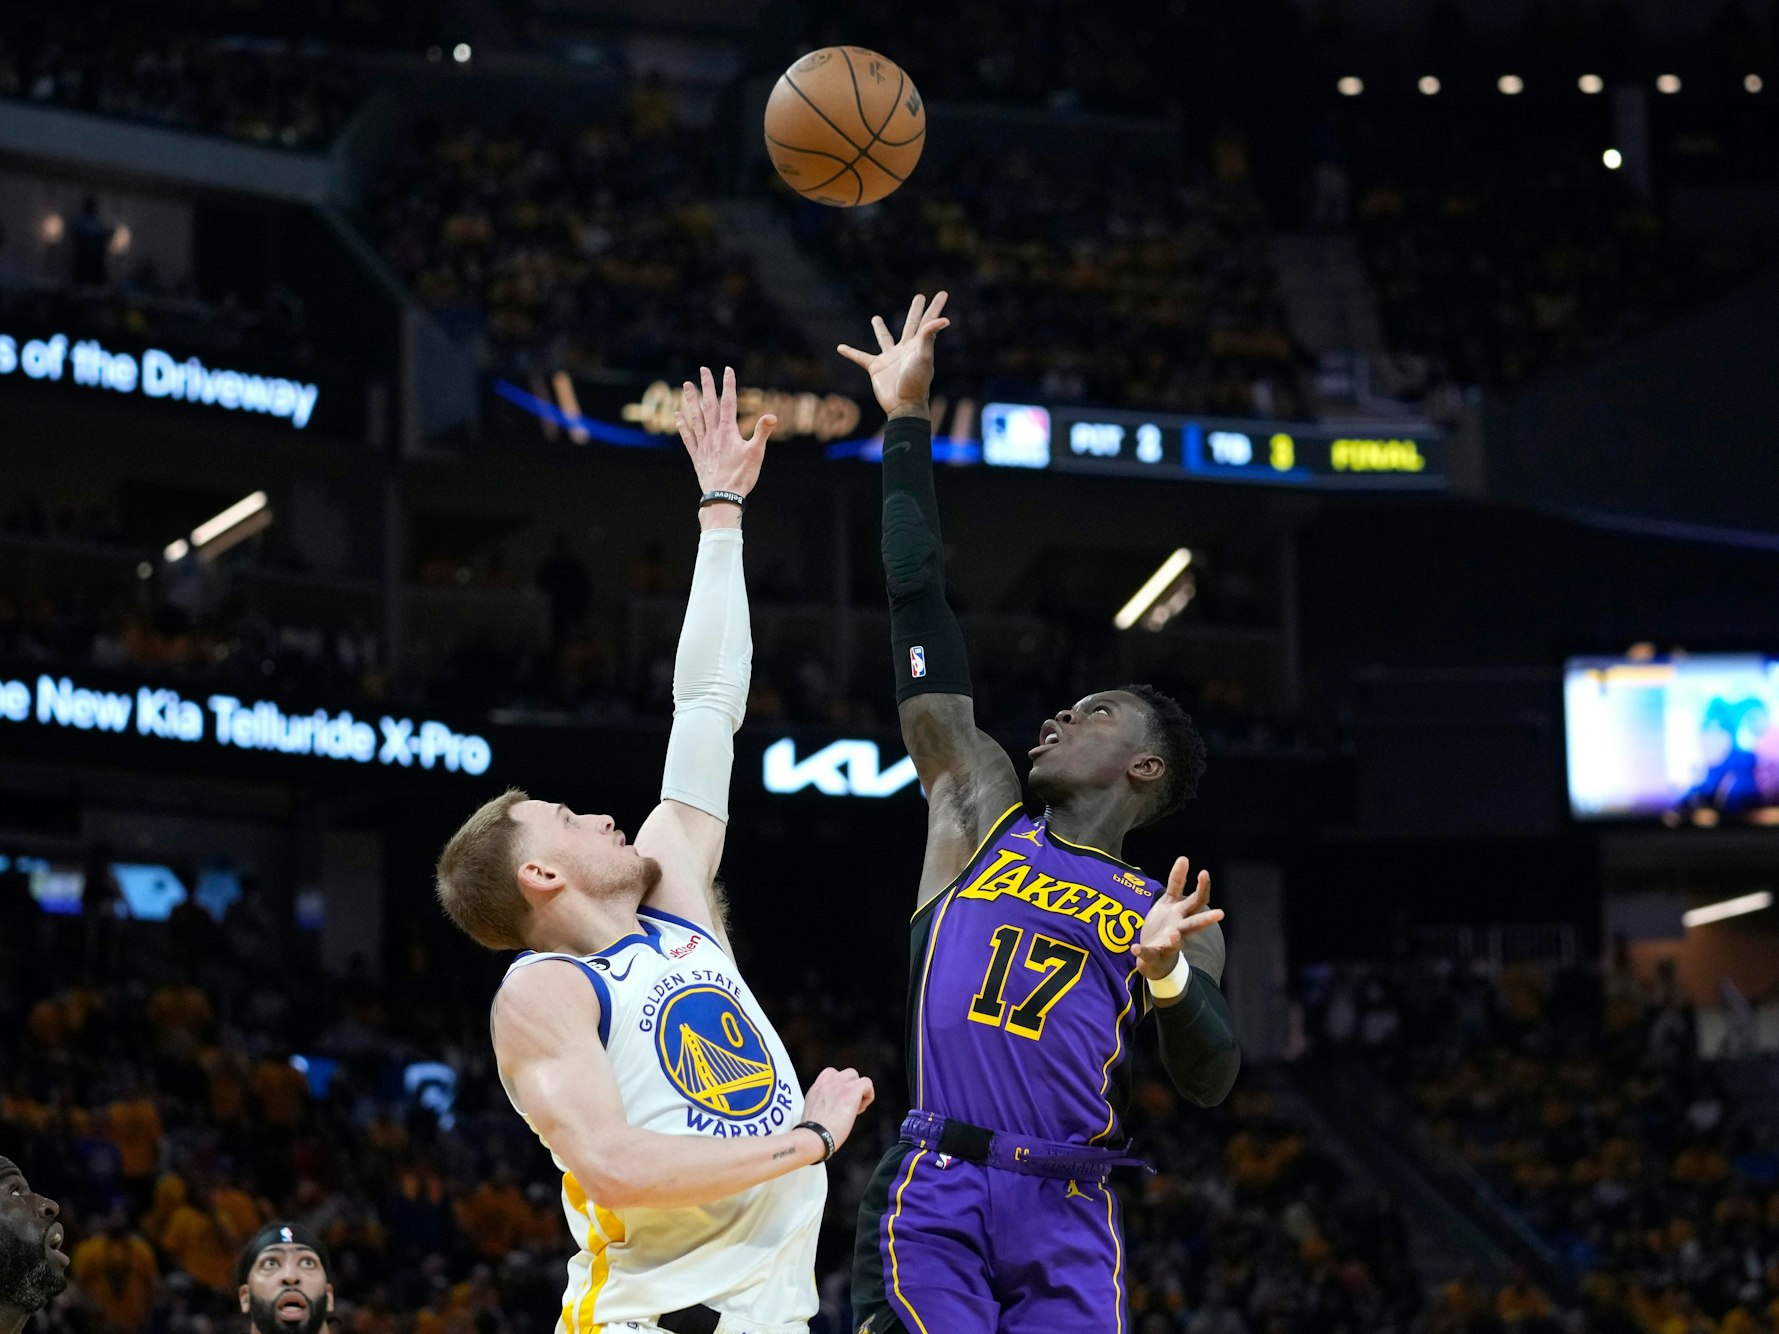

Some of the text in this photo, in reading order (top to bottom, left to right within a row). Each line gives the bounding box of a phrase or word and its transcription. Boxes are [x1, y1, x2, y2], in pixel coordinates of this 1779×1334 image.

[21, 333, 68, 379] of
[72, 341, 138, 392] the
[143, 350, 318, 427] Driveway
[1331, 439, 1424, 471] FINAL
[714, 491, 743, 504] Believe
[0, 675, 491, 775] e New Kia Telluride X-Pro
[956, 849, 1146, 954] LAKERS
[1112, 873, 1152, 897] bibigo
[639, 969, 742, 1033] GOLDEN STATE
[967, 924, 1090, 1041] 17
[720, 1010, 744, 1048] 0
[685, 1078, 793, 1140] WARRIORS
